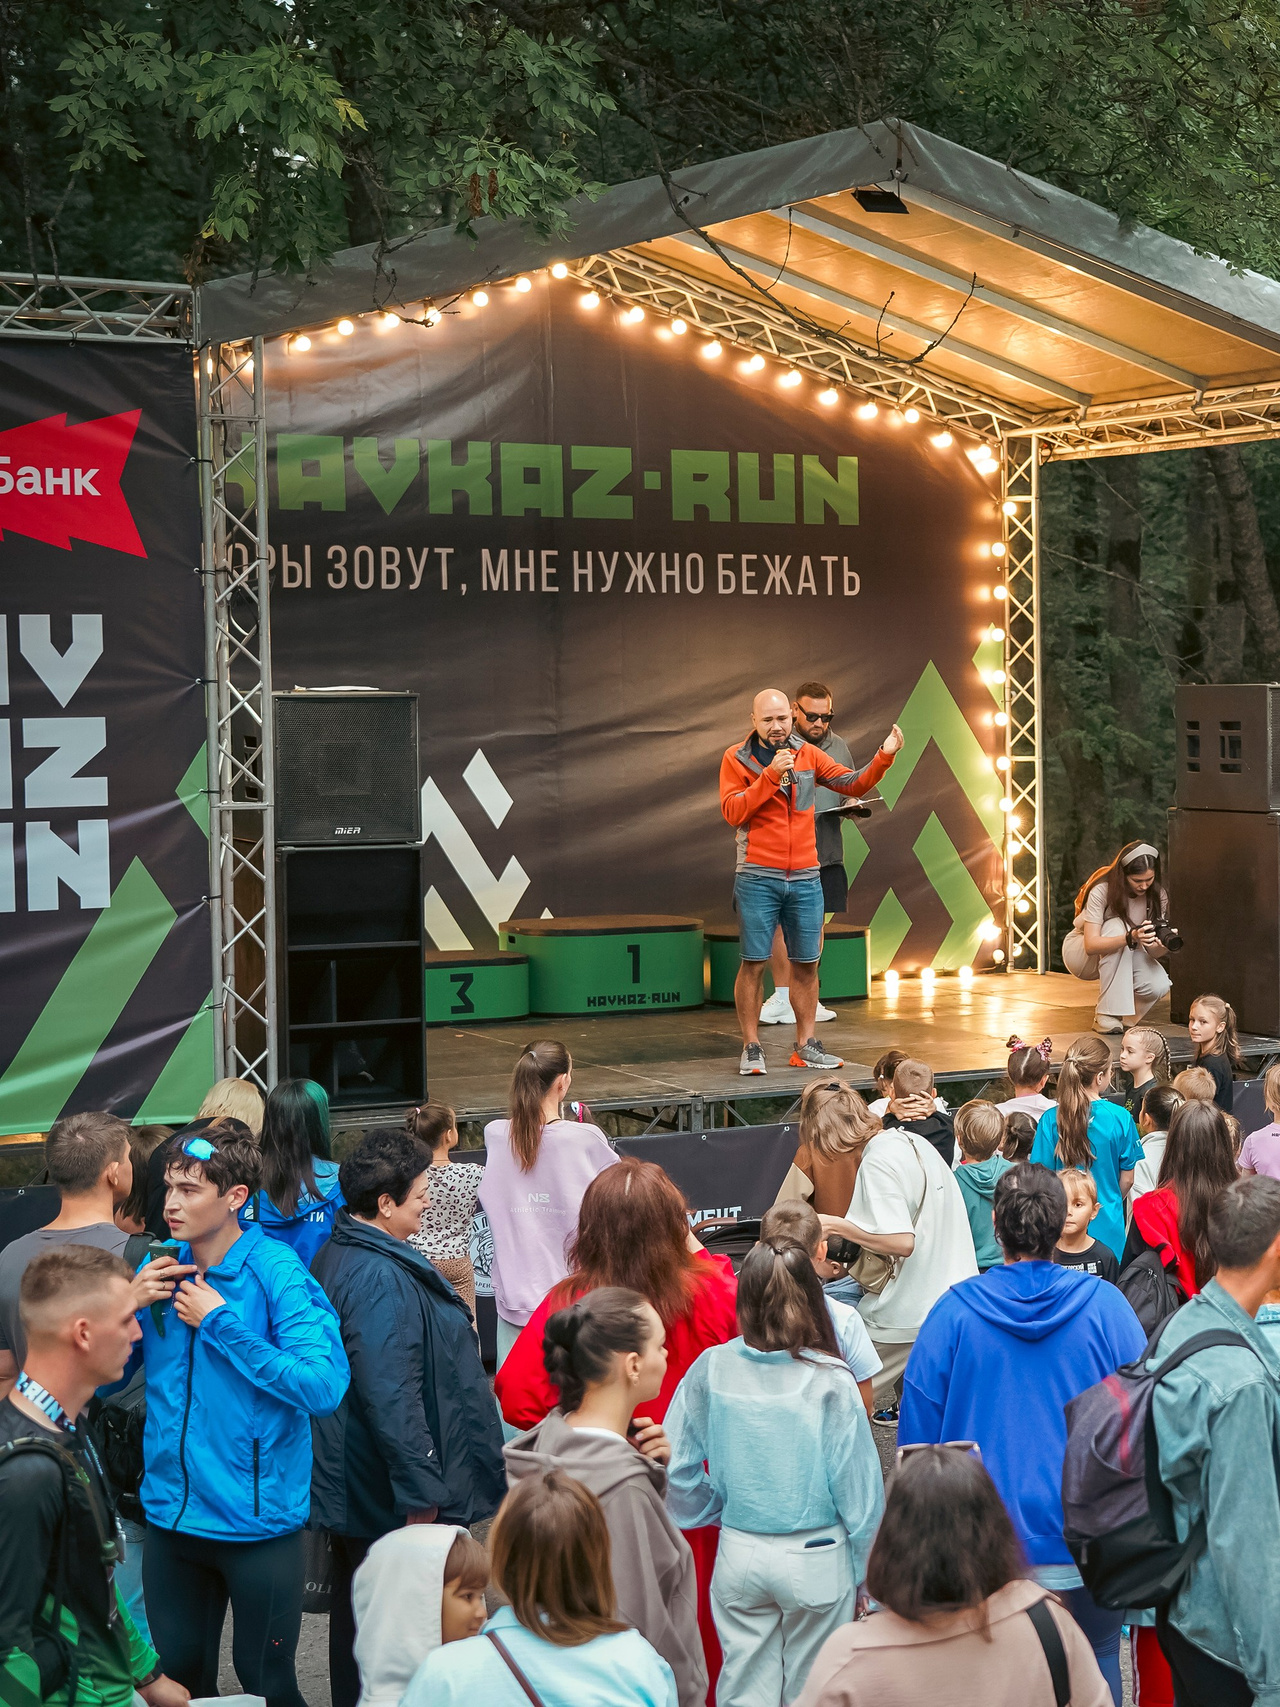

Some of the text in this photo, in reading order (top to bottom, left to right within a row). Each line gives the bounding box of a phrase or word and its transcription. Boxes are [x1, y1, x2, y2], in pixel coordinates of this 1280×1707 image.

[326, 544, 467, 596] ЗОВУТ,
[480, 548, 560, 593] МНЕ
[572, 550, 705, 595] НУЖНО
[717, 553, 861, 597] БЕЖАТЬ
[627, 944, 640, 984] 1
[450, 972, 475, 1015] 3
